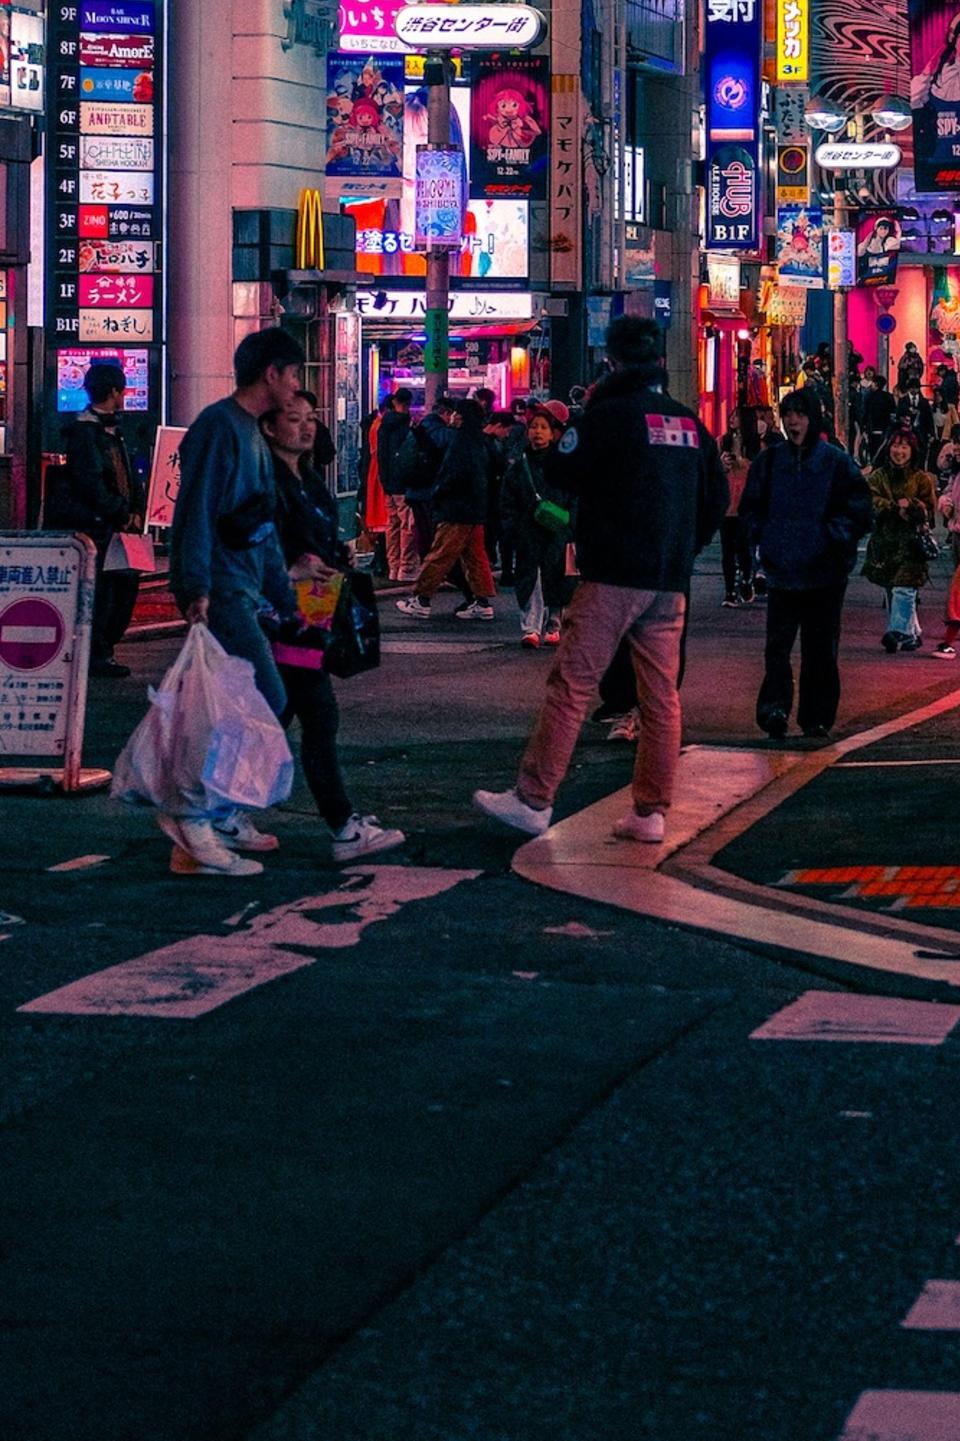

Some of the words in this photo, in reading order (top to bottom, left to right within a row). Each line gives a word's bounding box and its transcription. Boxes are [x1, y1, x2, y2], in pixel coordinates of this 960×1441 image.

[61, 7, 77, 21] 9F
[401, 16, 529, 34] 渋谷センター街
[60, 41, 77, 55] 8F
[350, 38, 398, 49] いちごなび
[783, 64, 801, 74] 3F
[60, 75, 76, 89] 7F
[60, 110, 77, 124] 6F
[88, 113, 147, 128] ANDTABLE
[59, 144, 76, 159] 5F
[555, 115, 574, 221] マモケバブ
[59, 179, 76, 193] 4F
[59, 213, 76, 228] 3F
[714, 224, 750, 241] B1F
[59, 249, 76, 263] 2F
[60, 284, 76, 298] 1F
[88, 288, 142, 304] ラーメン
[56, 317, 80, 332] B1F
[103, 316, 146, 335] ねぎし
